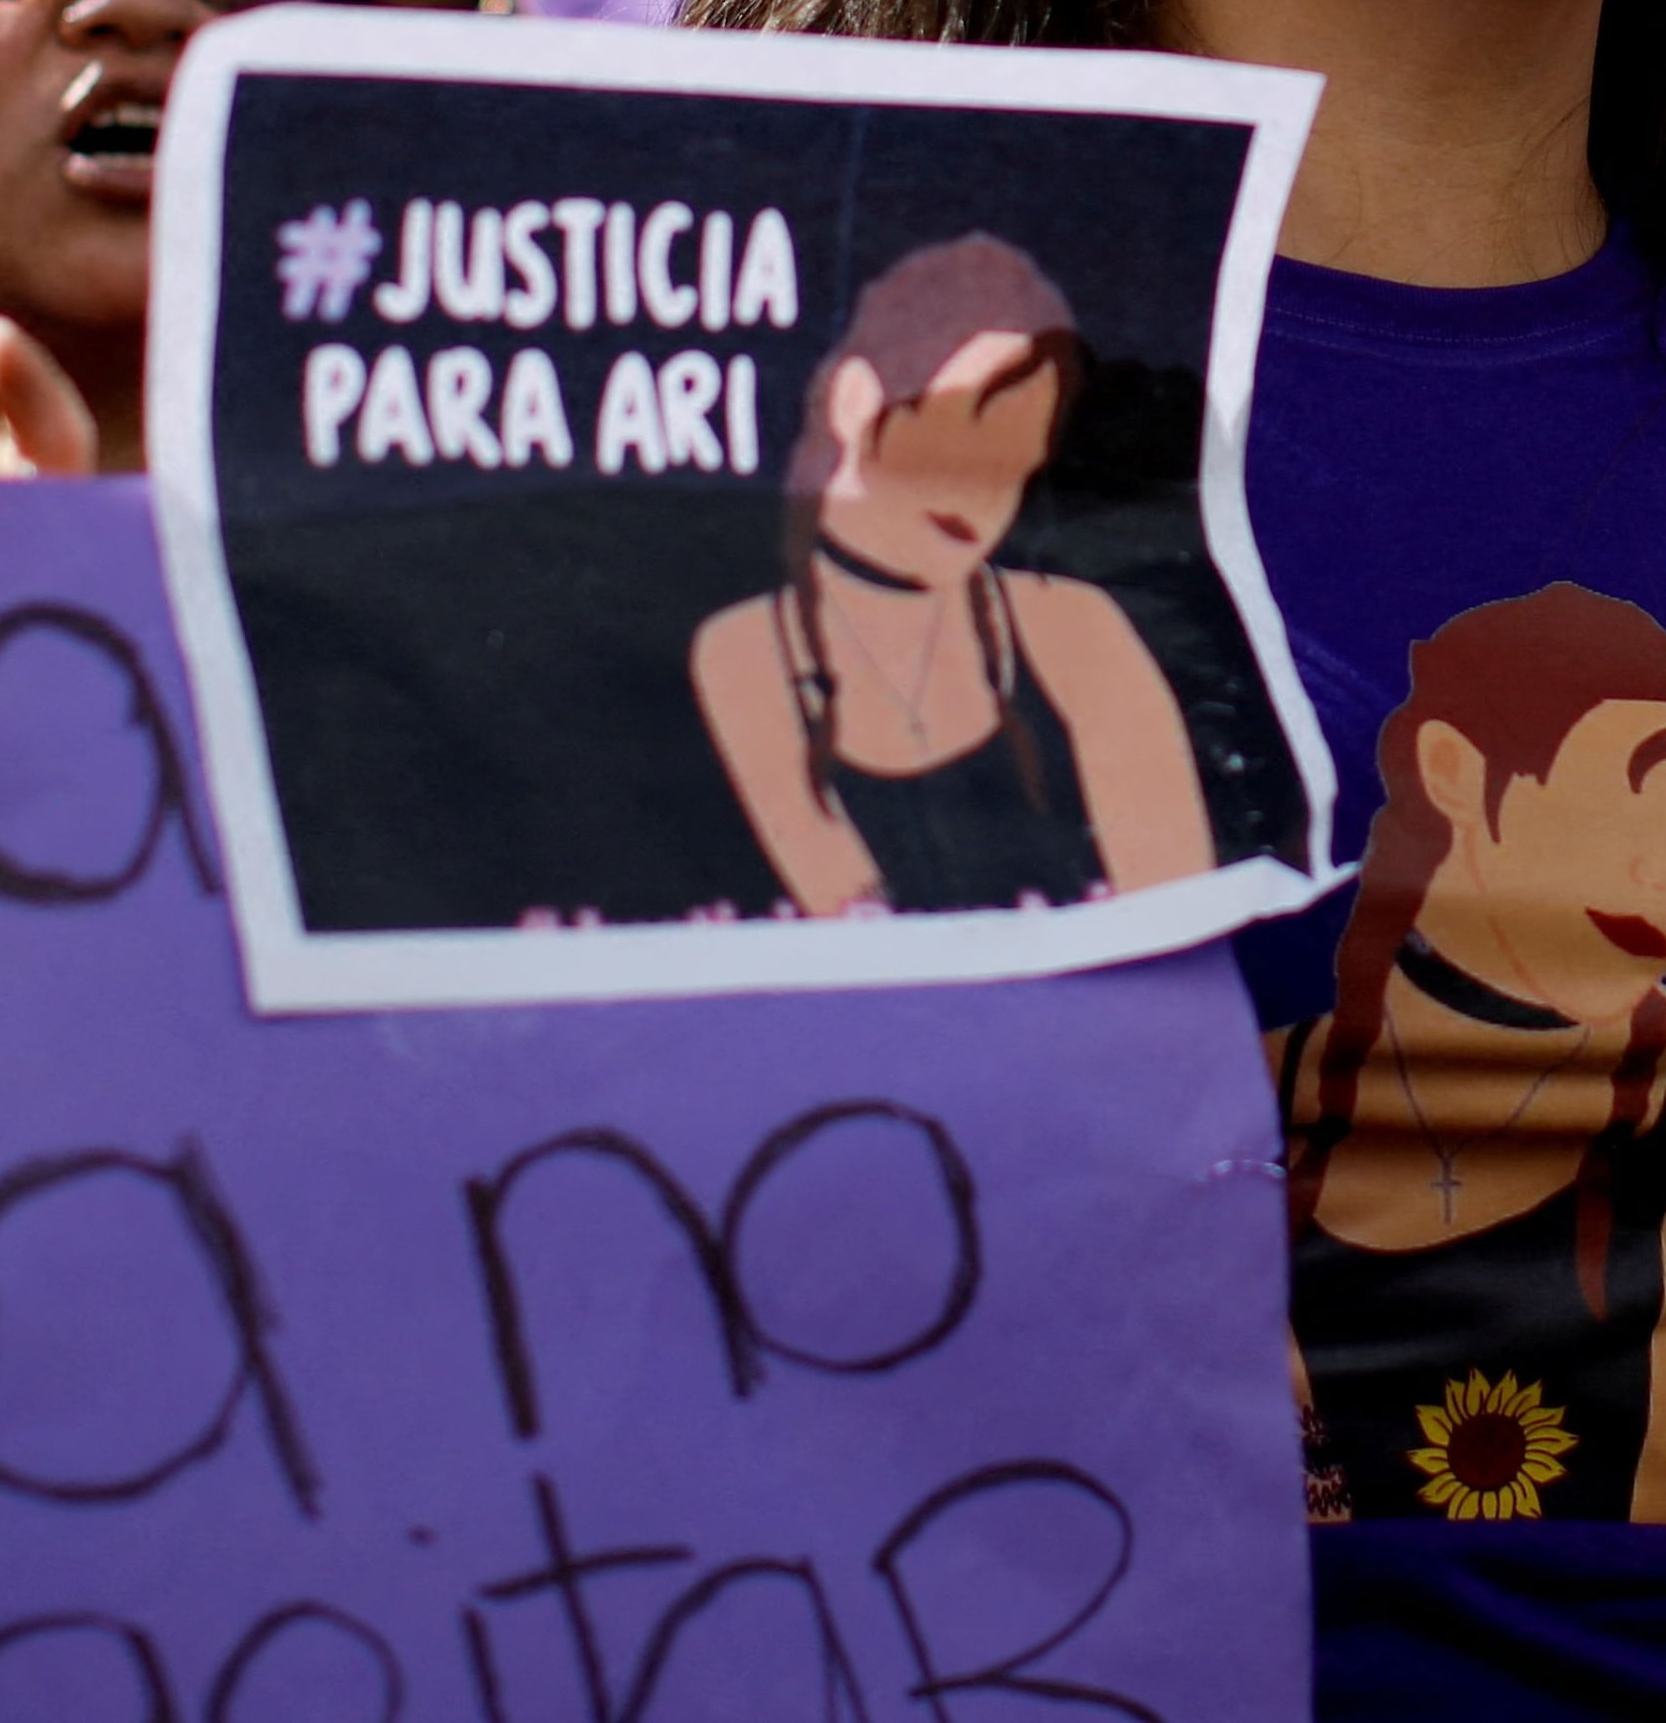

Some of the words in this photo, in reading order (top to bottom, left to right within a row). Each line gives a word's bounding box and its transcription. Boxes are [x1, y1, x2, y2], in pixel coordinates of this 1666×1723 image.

[276, 195, 799, 333] #JUSTICIA
[302, 343, 575, 472] PARA
[593, 351, 760, 475] ARI
[463, 1097, 983, 1443] no
